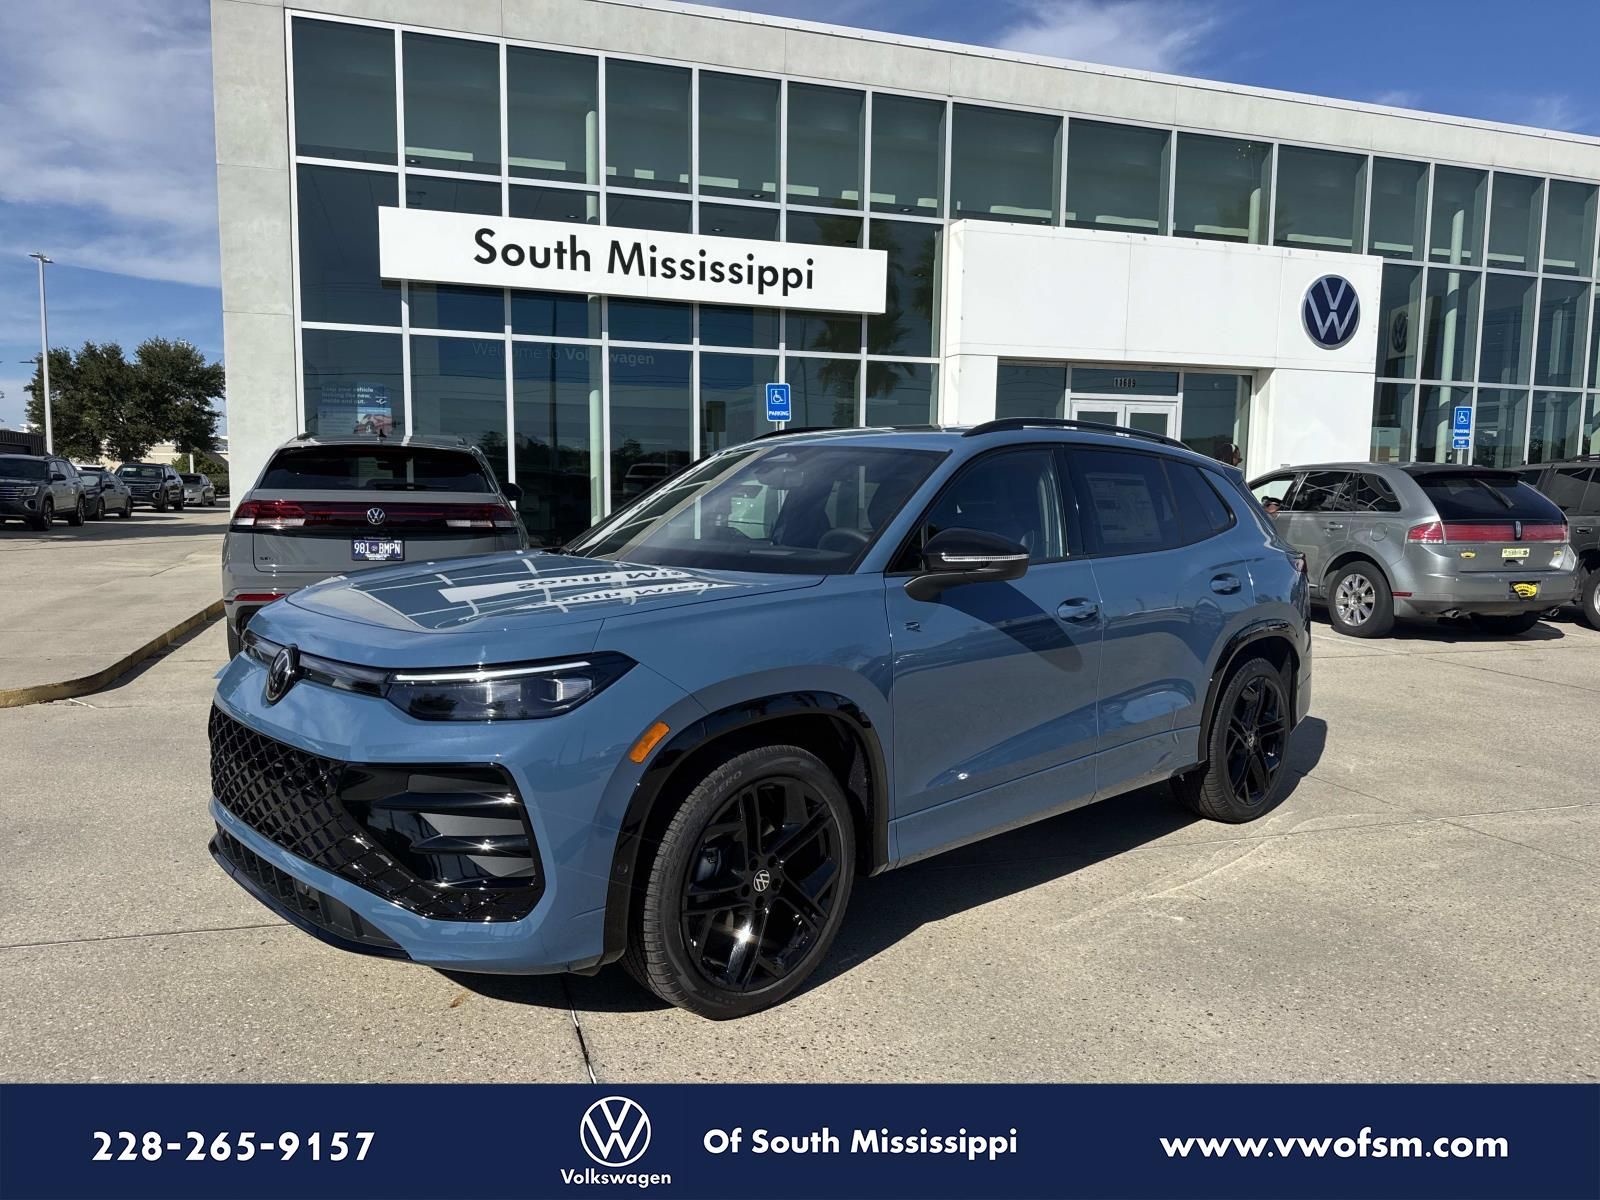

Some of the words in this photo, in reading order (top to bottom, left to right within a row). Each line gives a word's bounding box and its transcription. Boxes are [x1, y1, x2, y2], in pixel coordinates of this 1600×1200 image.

[474, 228, 591, 272] South
[607, 240, 814, 296] Mississippi
[565, 347, 654, 367] Volwagen
[354, 542, 370, 554] 981
[378, 542, 401, 554] BMPN
